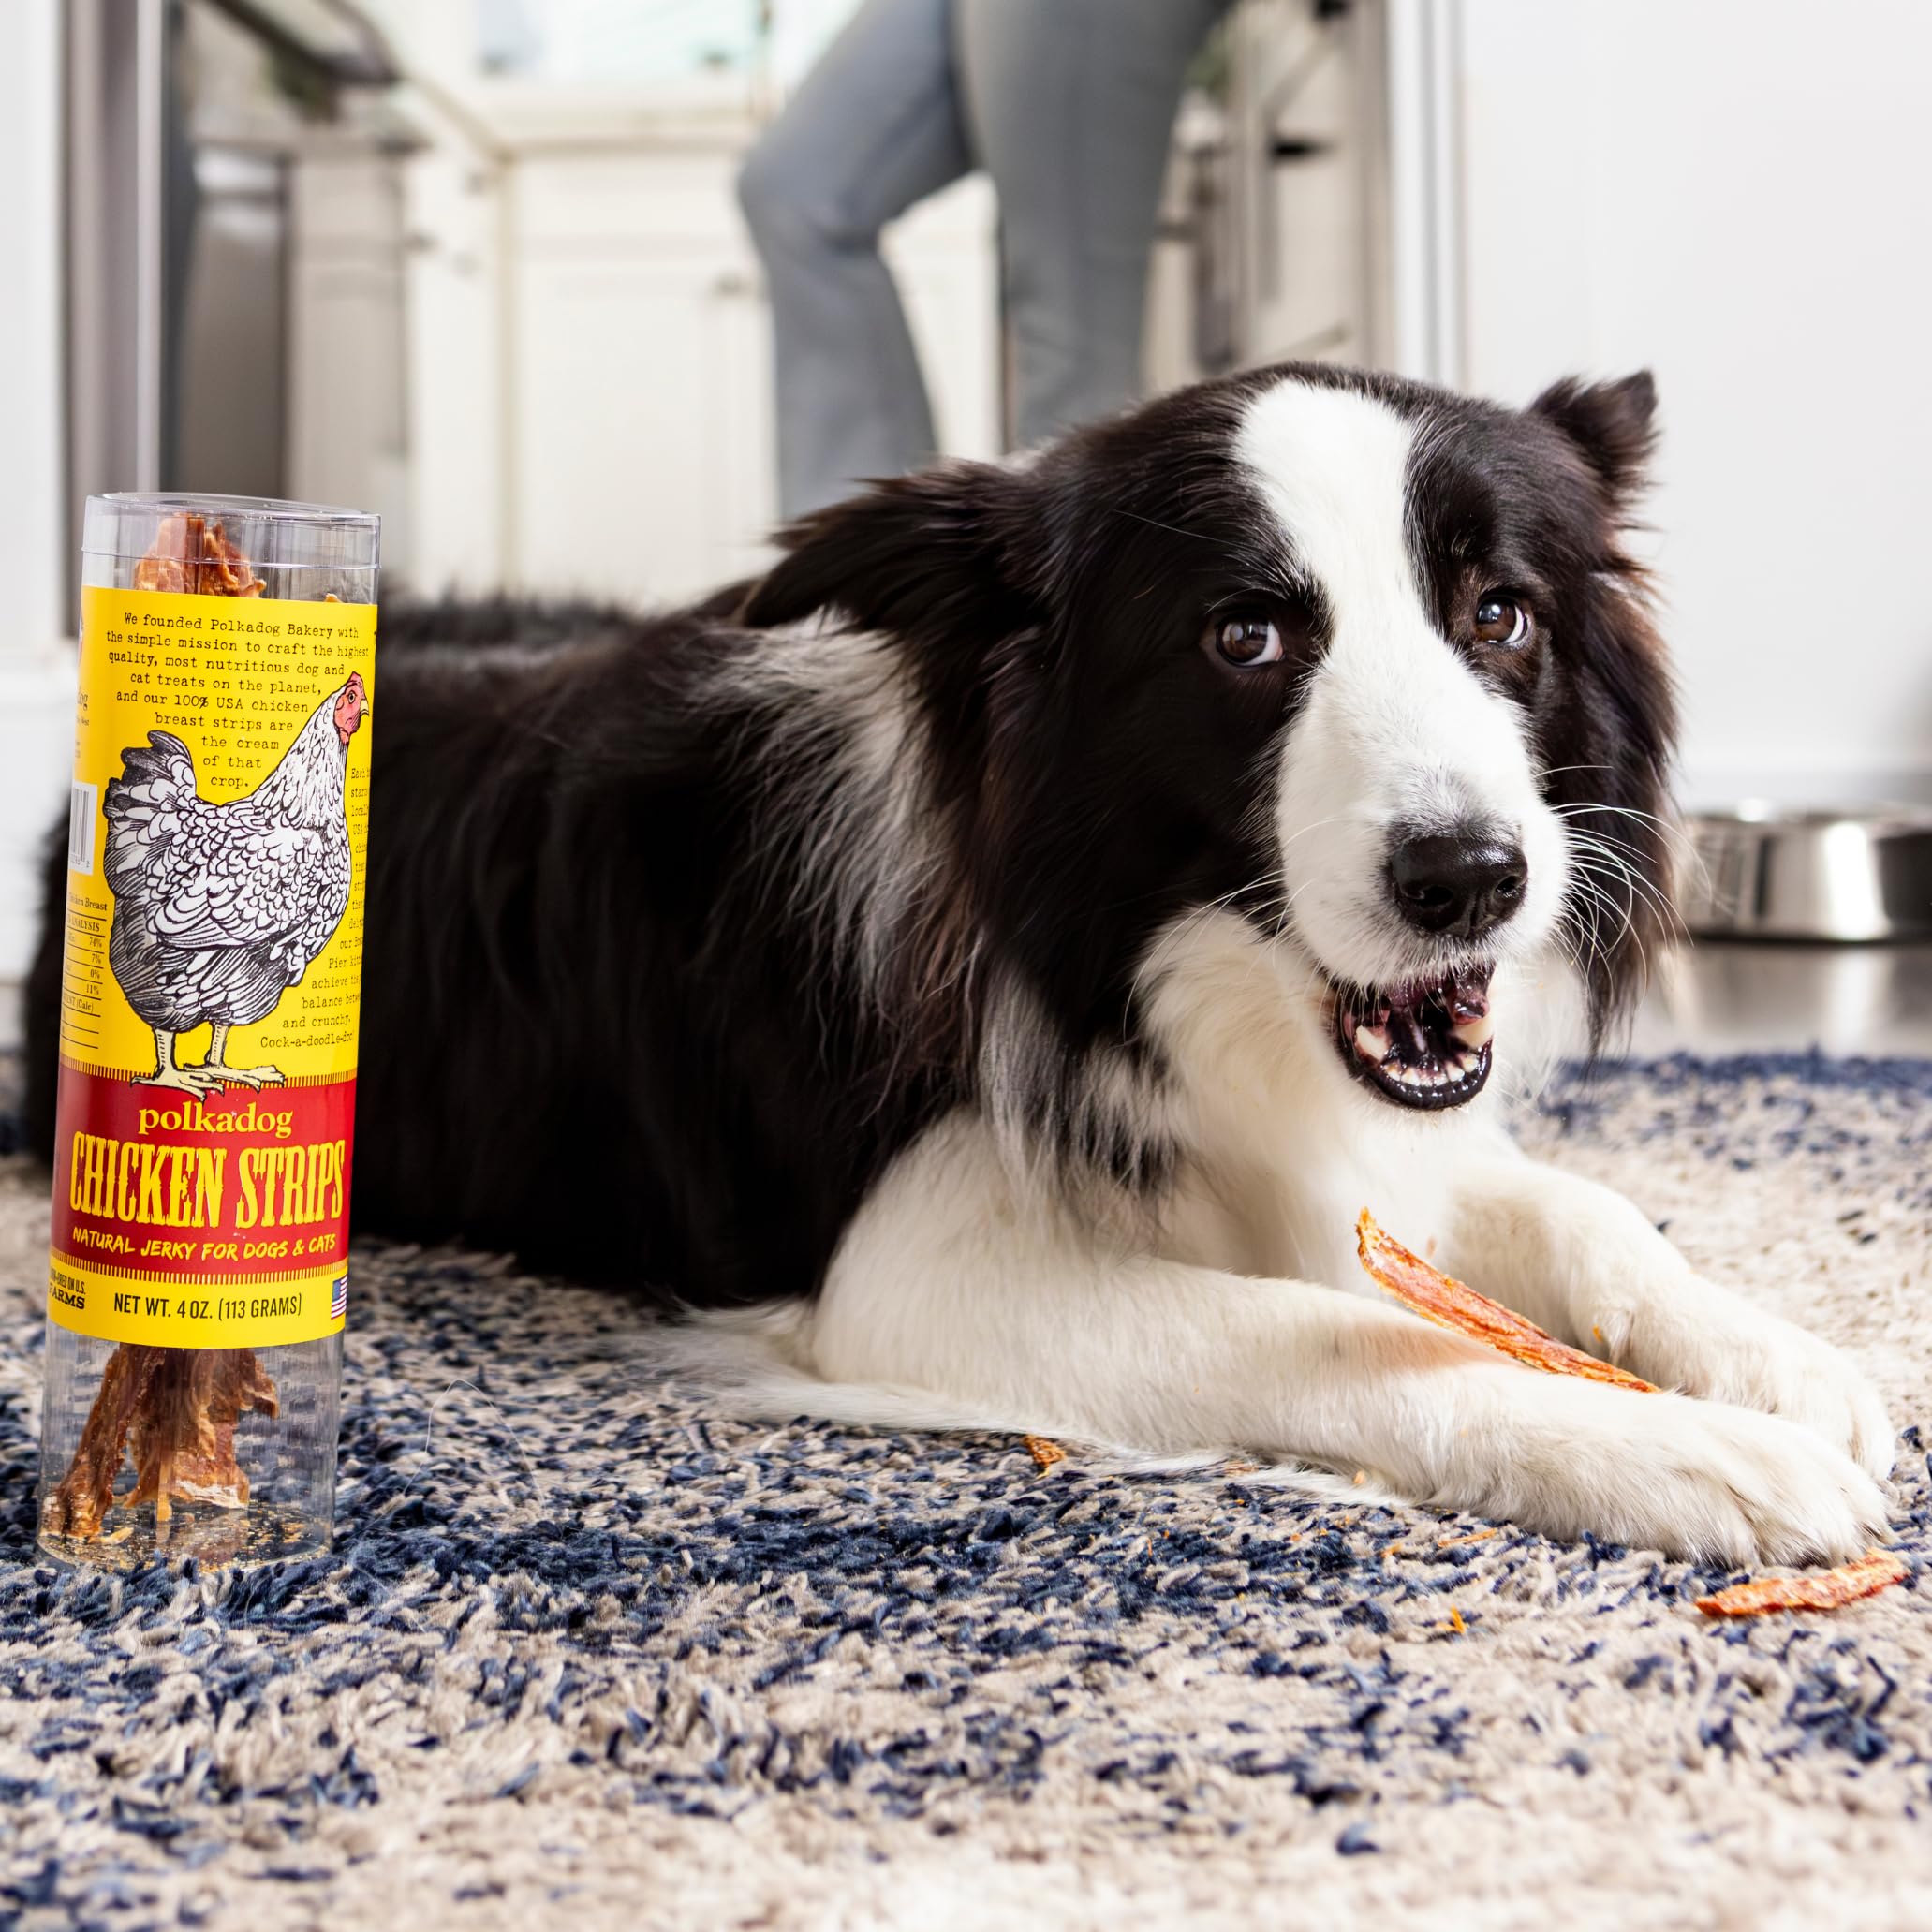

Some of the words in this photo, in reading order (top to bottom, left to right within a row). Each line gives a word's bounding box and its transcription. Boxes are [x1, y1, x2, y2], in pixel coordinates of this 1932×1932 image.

[125, 612, 138, 625] We
[143, 613, 202, 630] founded
[211, 619, 280, 637] Polkadog
[288, 624, 332, 640] Bakery
[338, 627, 359, 638] with
[107, 630, 123, 643] the
[127, 632, 170, 647] simple
[178, 637, 237, 652] mission
[246, 642, 260, 653] to
[268, 642, 306, 655] craft
[312, 644, 332, 656] the
[337, 645, 369, 659] highest
[109, 651, 158, 667] quality,
[166, 657, 197, 669] most
[206, 658, 289, 673] nutritious
[297, 663, 318, 677] dog
[325, 663, 345, 675] and
[130, 672, 150, 685] cat
[158, 673, 205, 689] treats
[213, 680, 229, 690] on
[239, 679, 262, 692] the
[270, 682, 321, 696] planet,
[116, 689, 138, 701] and
[144, 693, 167, 704] our
[174, 694, 209, 708] 100%
[216, 696, 243, 710] USA
[252, 700, 309, 713] chicken
[155, 712, 204, 727] breast
[213, 716, 262, 732] strips
[270, 719, 293, 731] are
[202, 735, 227, 747] the
[237, 739, 279, 750] cream
[203, 755, 219, 766] of
[228, 756, 261, 769] that
[211, 774, 249, 789] crop.
[85, 897, 107, 911] Breast
[90, 937, 103, 948] 74%
[339, 939, 352, 950] our
[92, 953, 101, 964] 7%
[329, 958, 347, 969] Pier
[90, 968, 100, 980] 0%
[86, 983, 99, 995] 11%
[311, 976, 347, 989] achieve
[302, 996, 342, 1009] balance
[282, 1017, 306, 1028] and
[138, 1101, 293, 1139] polkadog
[69, 1130, 227, 1229] CHICKEN
[236, 1139, 347, 1230] STRIPS
[73, 1227, 135, 1253] NATURAL
[141, 1239, 196, 1260] JERKY
[202, 1243, 238, 1261] FOR
[244, 1241, 288, 1259] DOGS
[292, 1240, 304, 1255] &
[309, 1233, 336, 1254] CATS
[76, 1279, 86, 1294] U.S.
[114, 1292, 141, 1314] NET
[145, 1298, 171, 1317] WT.
[177, 1300, 186, 1319] 4
[189, 1300, 213, 1320] OZ.
[218, 1297, 245, 1321] (113
[251, 1292, 302, 1318] GRAMS)
